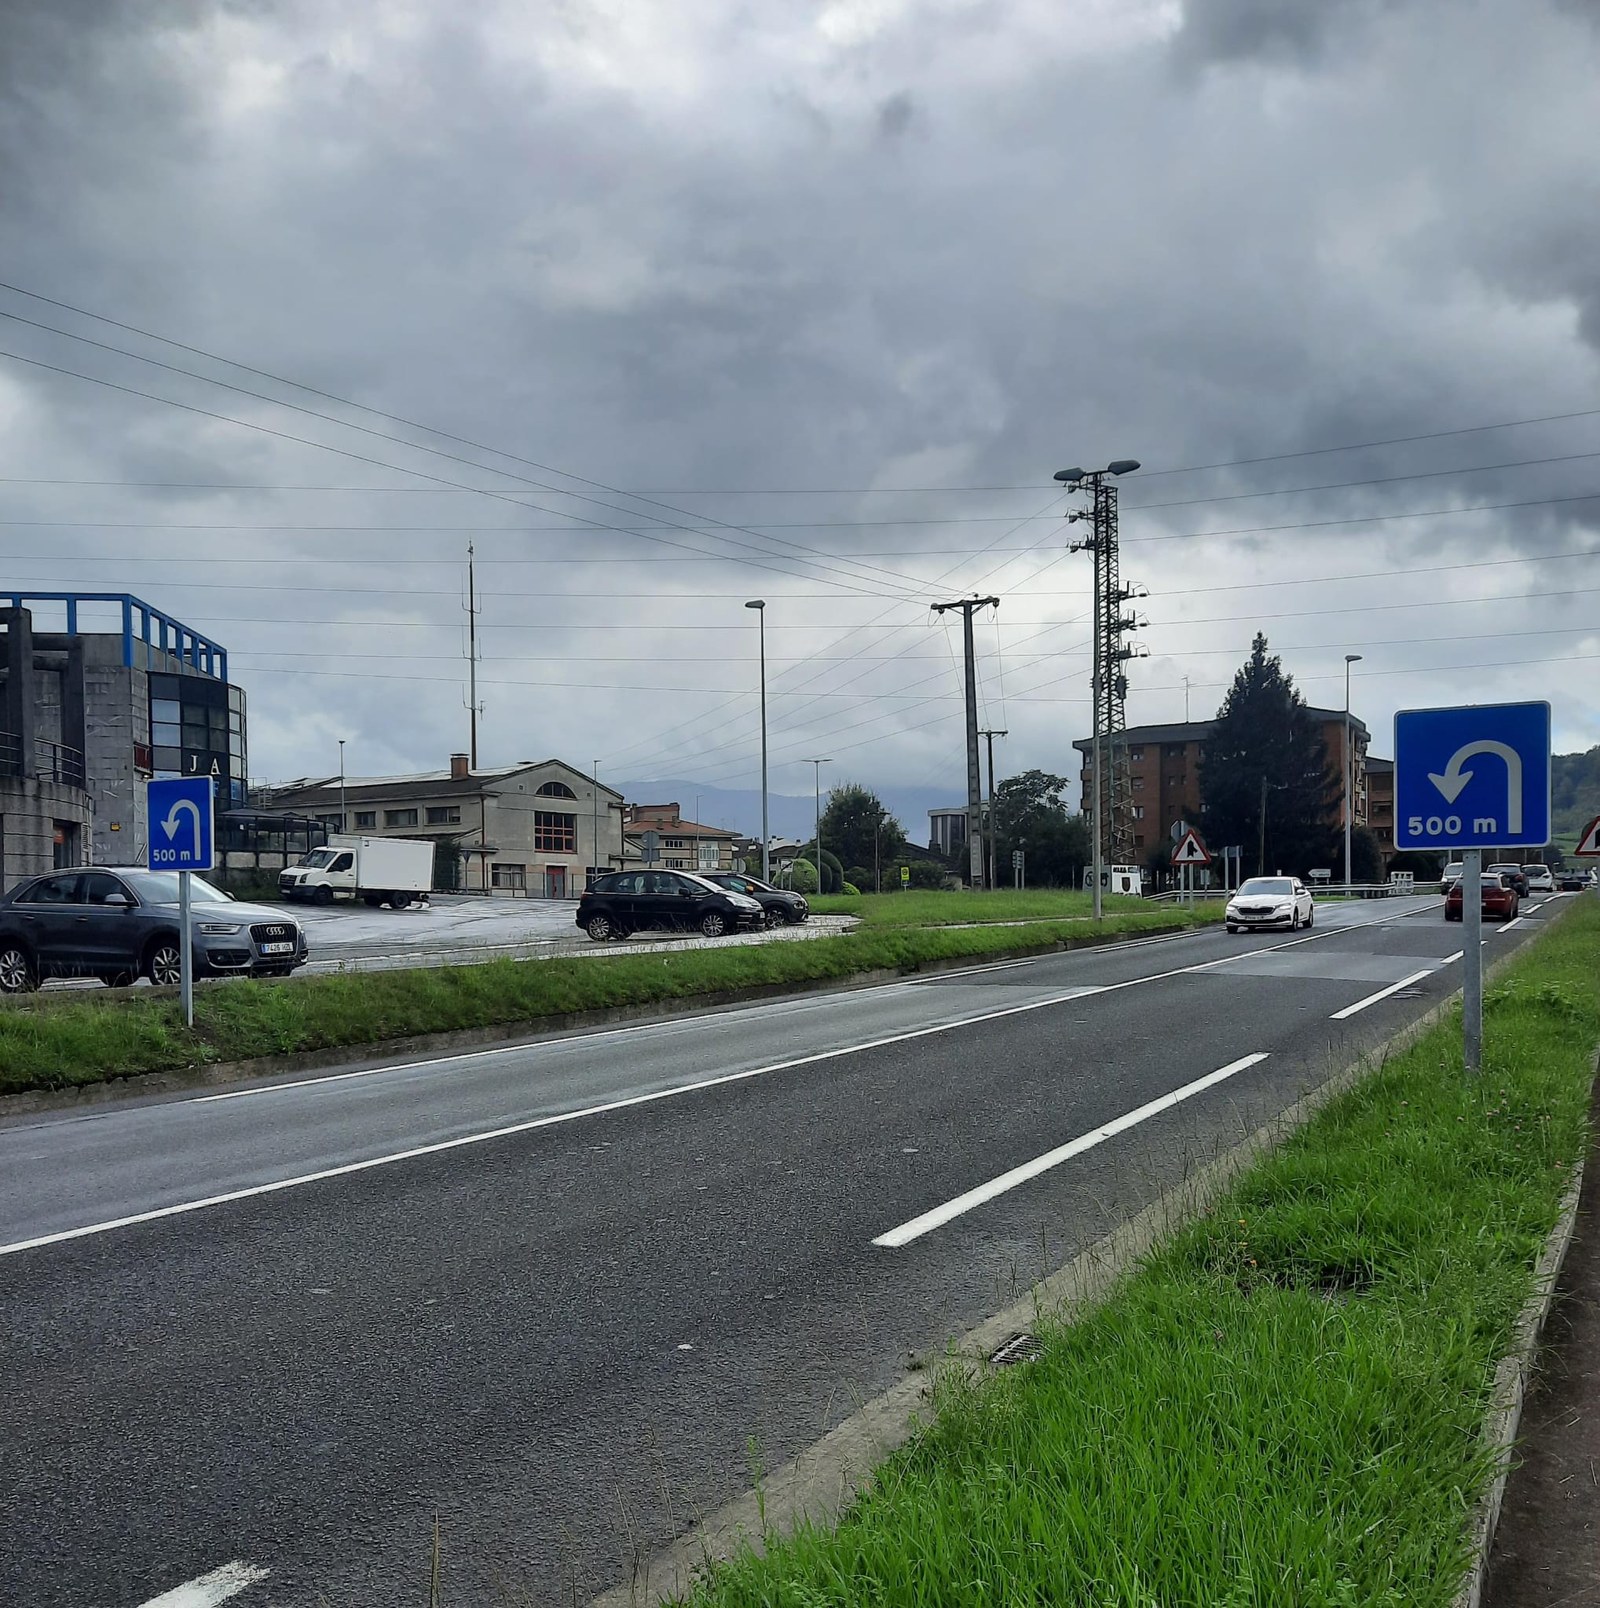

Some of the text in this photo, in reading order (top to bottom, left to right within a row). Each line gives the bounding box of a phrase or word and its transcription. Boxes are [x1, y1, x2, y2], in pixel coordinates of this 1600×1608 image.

[1408, 815, 1497, 836] 500 m
[153, 848, 190, 862] 500 m
